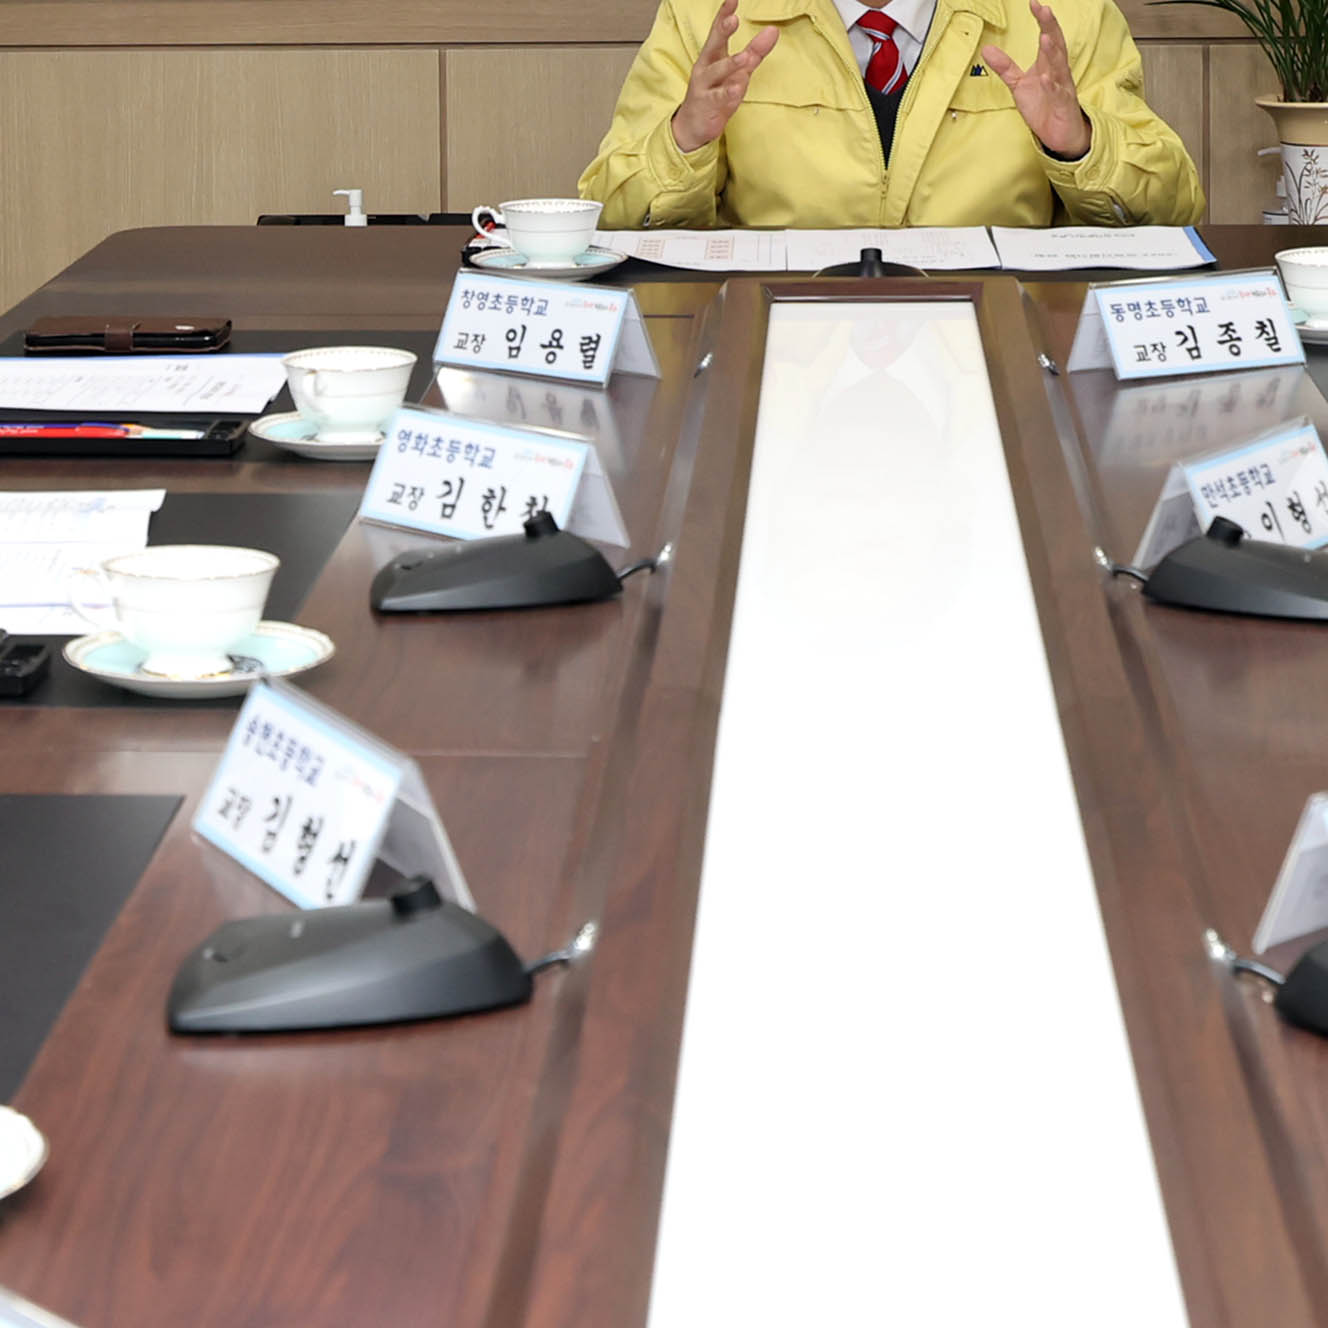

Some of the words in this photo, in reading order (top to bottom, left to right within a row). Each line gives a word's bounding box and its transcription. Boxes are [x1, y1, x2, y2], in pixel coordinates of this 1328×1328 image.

[461, 289, 549, 317] 창영초등학교
[1109, 296, 1211, 323] 동명초등학교
[453, 332, 486, 354] 교장
[1133, 343, 1167, 363] 교장
[398, 429, 496, 469] 영화초등학교
[386, 482, 425, 511] 교장
